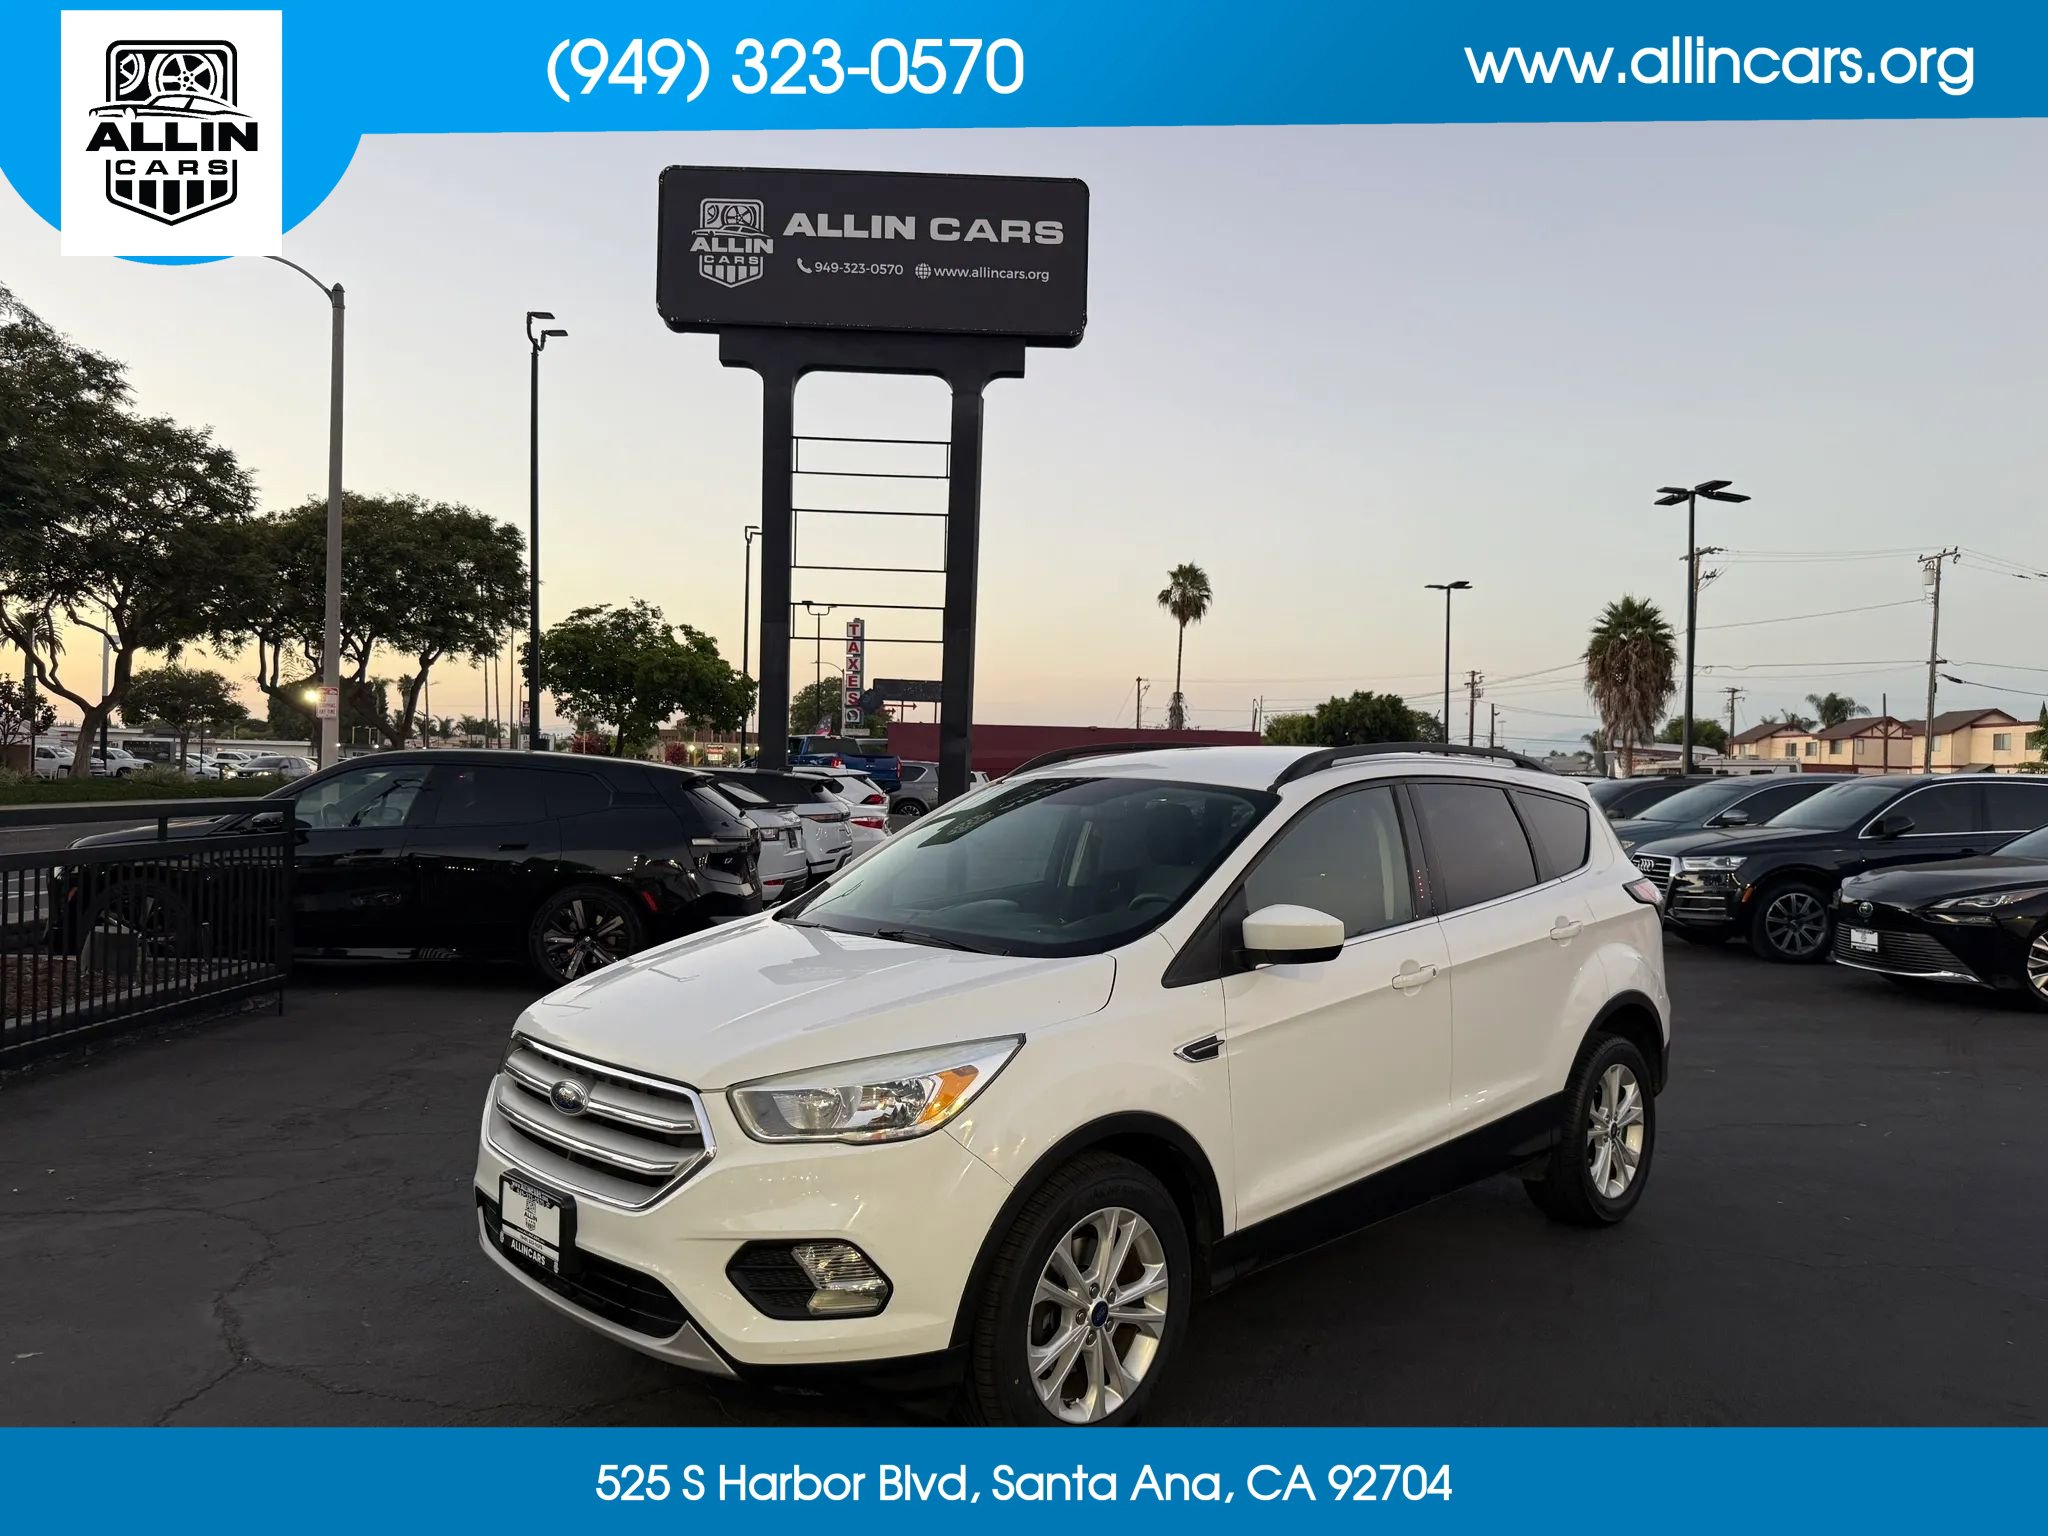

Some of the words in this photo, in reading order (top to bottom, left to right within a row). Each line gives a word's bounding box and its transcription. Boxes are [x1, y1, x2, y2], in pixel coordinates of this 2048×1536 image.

[783, 212, 916, 240] ALLIN
[930, 218, 1064, 245] CARS
[689, 235, 774, 255] ALLIN
[704, 254, 760, 266] CARS
[814, 261, 904, 276] 949-323-0570
[933, 265, 1050, 283] www.allincars.org
[847, 624, 860, 705] TAXES
[510, 1239, 546, 1266] ALLINCARS
